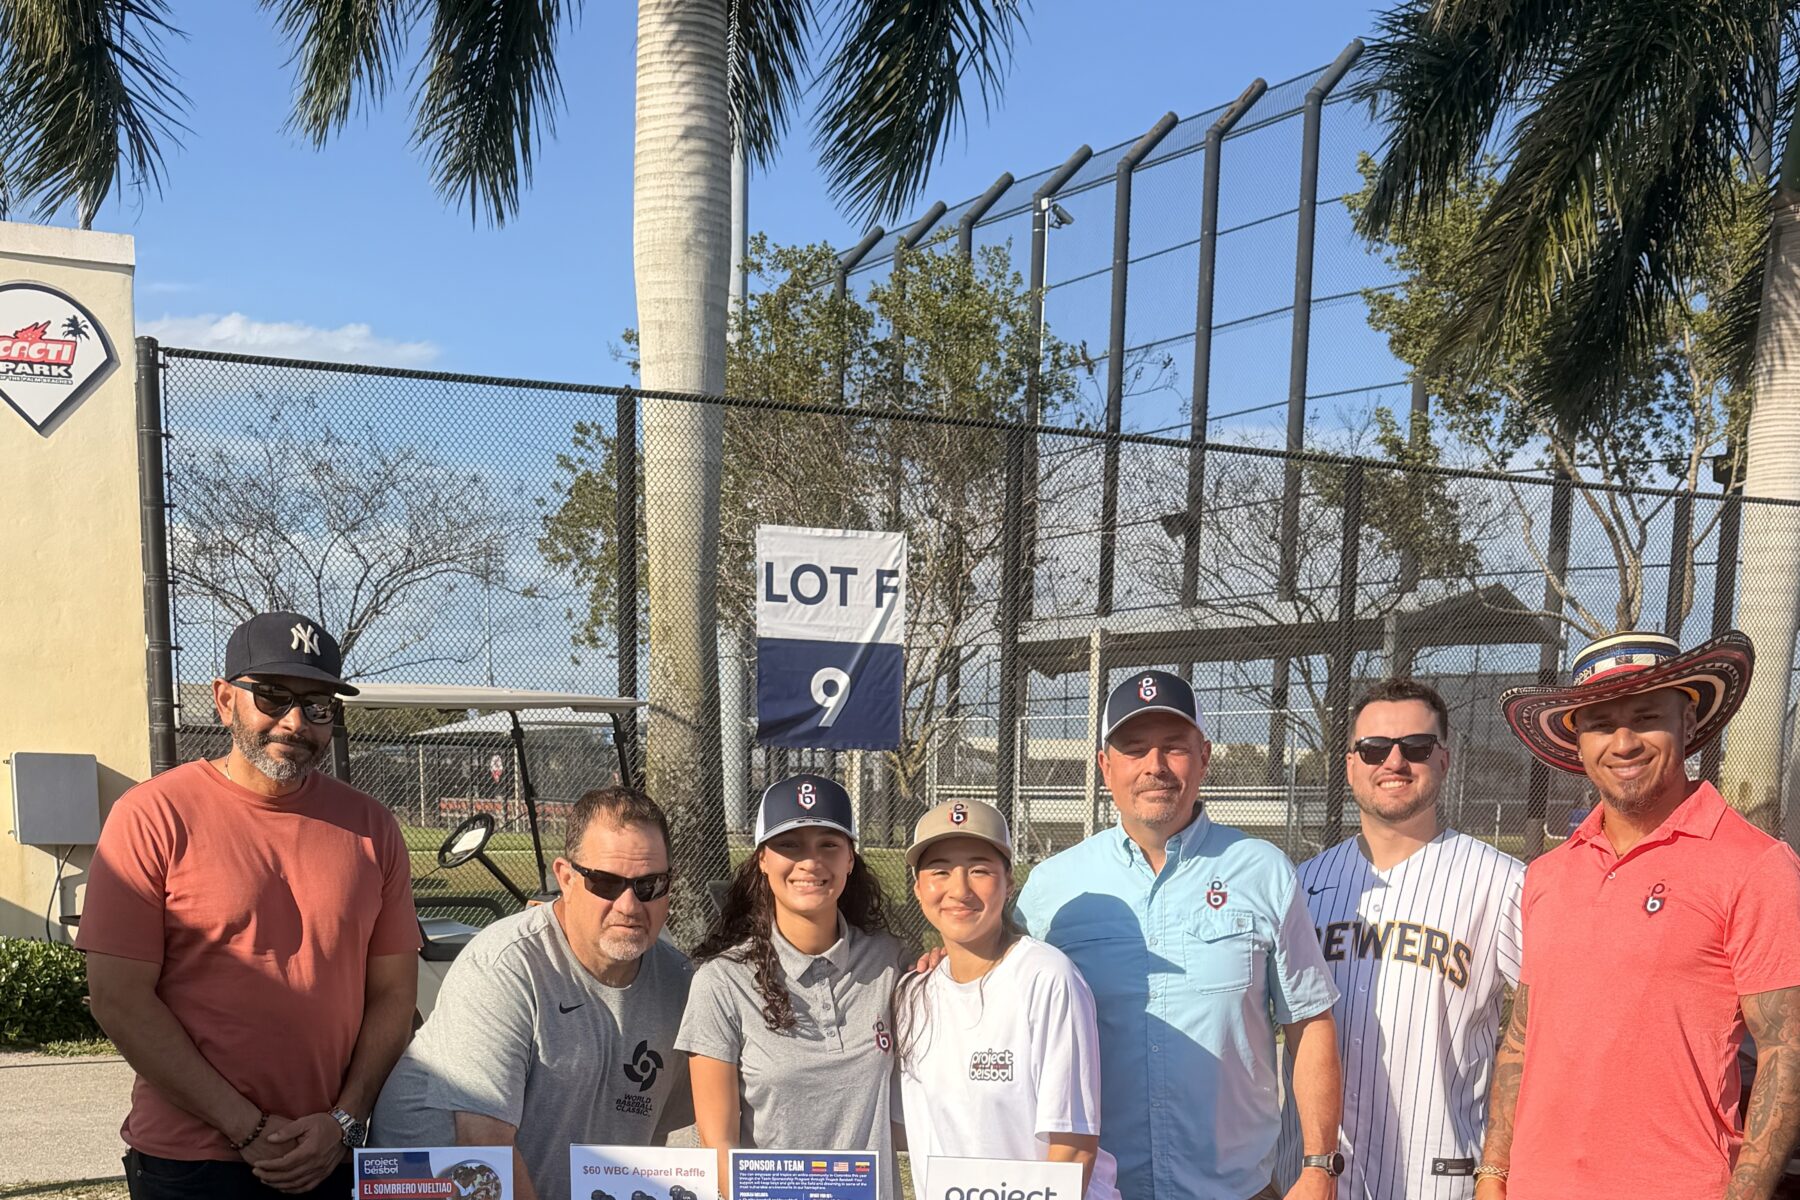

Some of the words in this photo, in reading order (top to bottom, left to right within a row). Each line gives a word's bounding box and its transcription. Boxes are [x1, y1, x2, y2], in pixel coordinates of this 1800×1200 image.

[0, 340, 73, 361] CACTI
[0, 361, 71, 377] PARK
[765, 561, 859, 607] LOT
[875, 568, 900, 609] F
[290, 622, 321, 656] NY
[810, 666, 851, 728] 9
[1315, 920, 1472, 991] EWERS
[971, 1048, 1014, 1067] project
[616, 1098, 653, 1112] BASEBALL
[624, 1093, 652, 1104] WORLD
[364, 1157, 399, 1169] project
[739, 1160, 775, 1171] SPONSOR
[776, 1161, 782, 1171] A
[783, 1161, 805, 1171] TEAM
[583, 1165, 601, 1176] $60
[603, 1166, 629, 1176] WBC
[632, 1167, 673, 1178] Apparel
[675, 1168, 706, 1177] Raffle
[364, 1184, 373, 1195] EL
[373, 1183, 416, 1194] SOMBRERO
[417, 1182, 452, 1194] VUELTIAO
